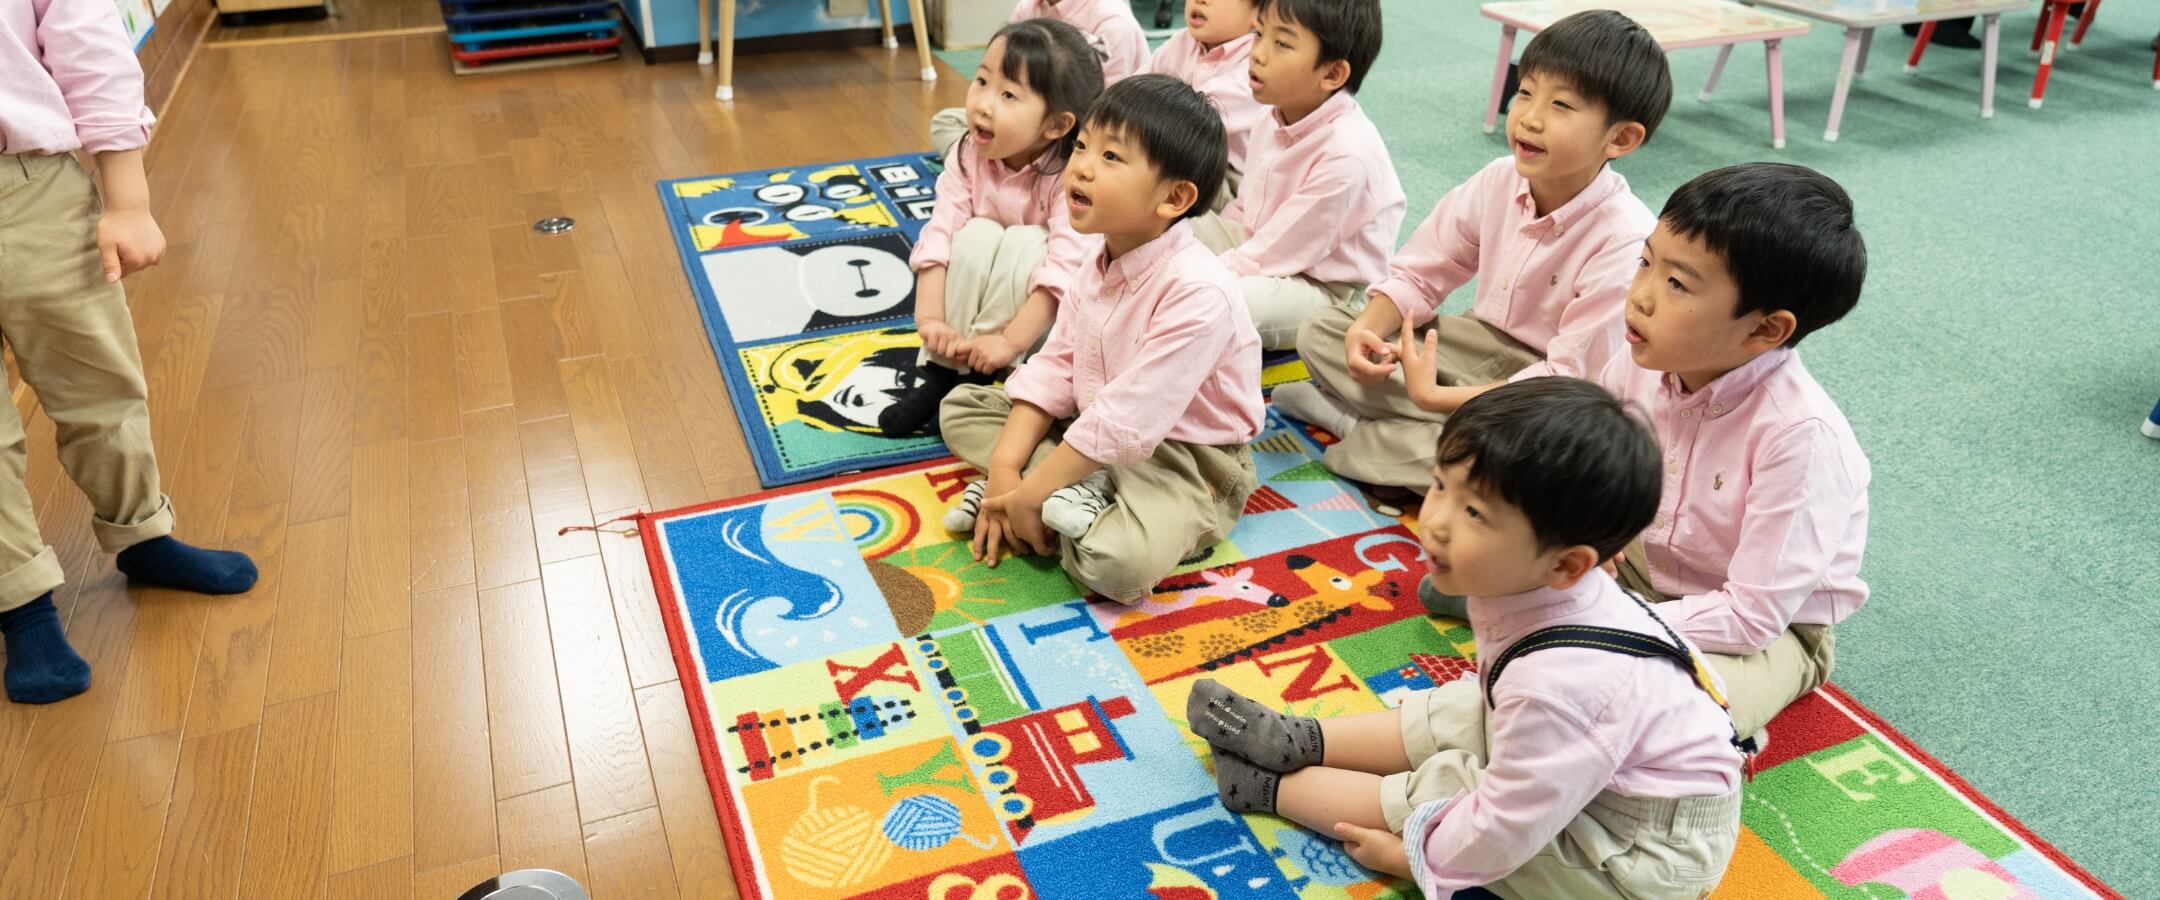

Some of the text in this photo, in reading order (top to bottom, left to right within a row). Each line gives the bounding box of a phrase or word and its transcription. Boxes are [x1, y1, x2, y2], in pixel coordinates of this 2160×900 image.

[767, 495, 846, 543] W
[1354, 533, 1428, 573] G
[1019, 602, 1110, 645] T
[826, 642, 921, 706] X
[1252, 645, 1360, 703] N
[1307, 726, 1319, 753] MAIN
[876, 739, 977, 796] Y
[1262, 776, 1272, 807] MAIN
[1804, 740, 1917, 802] E
[1152, 798, 1258, 866] U
